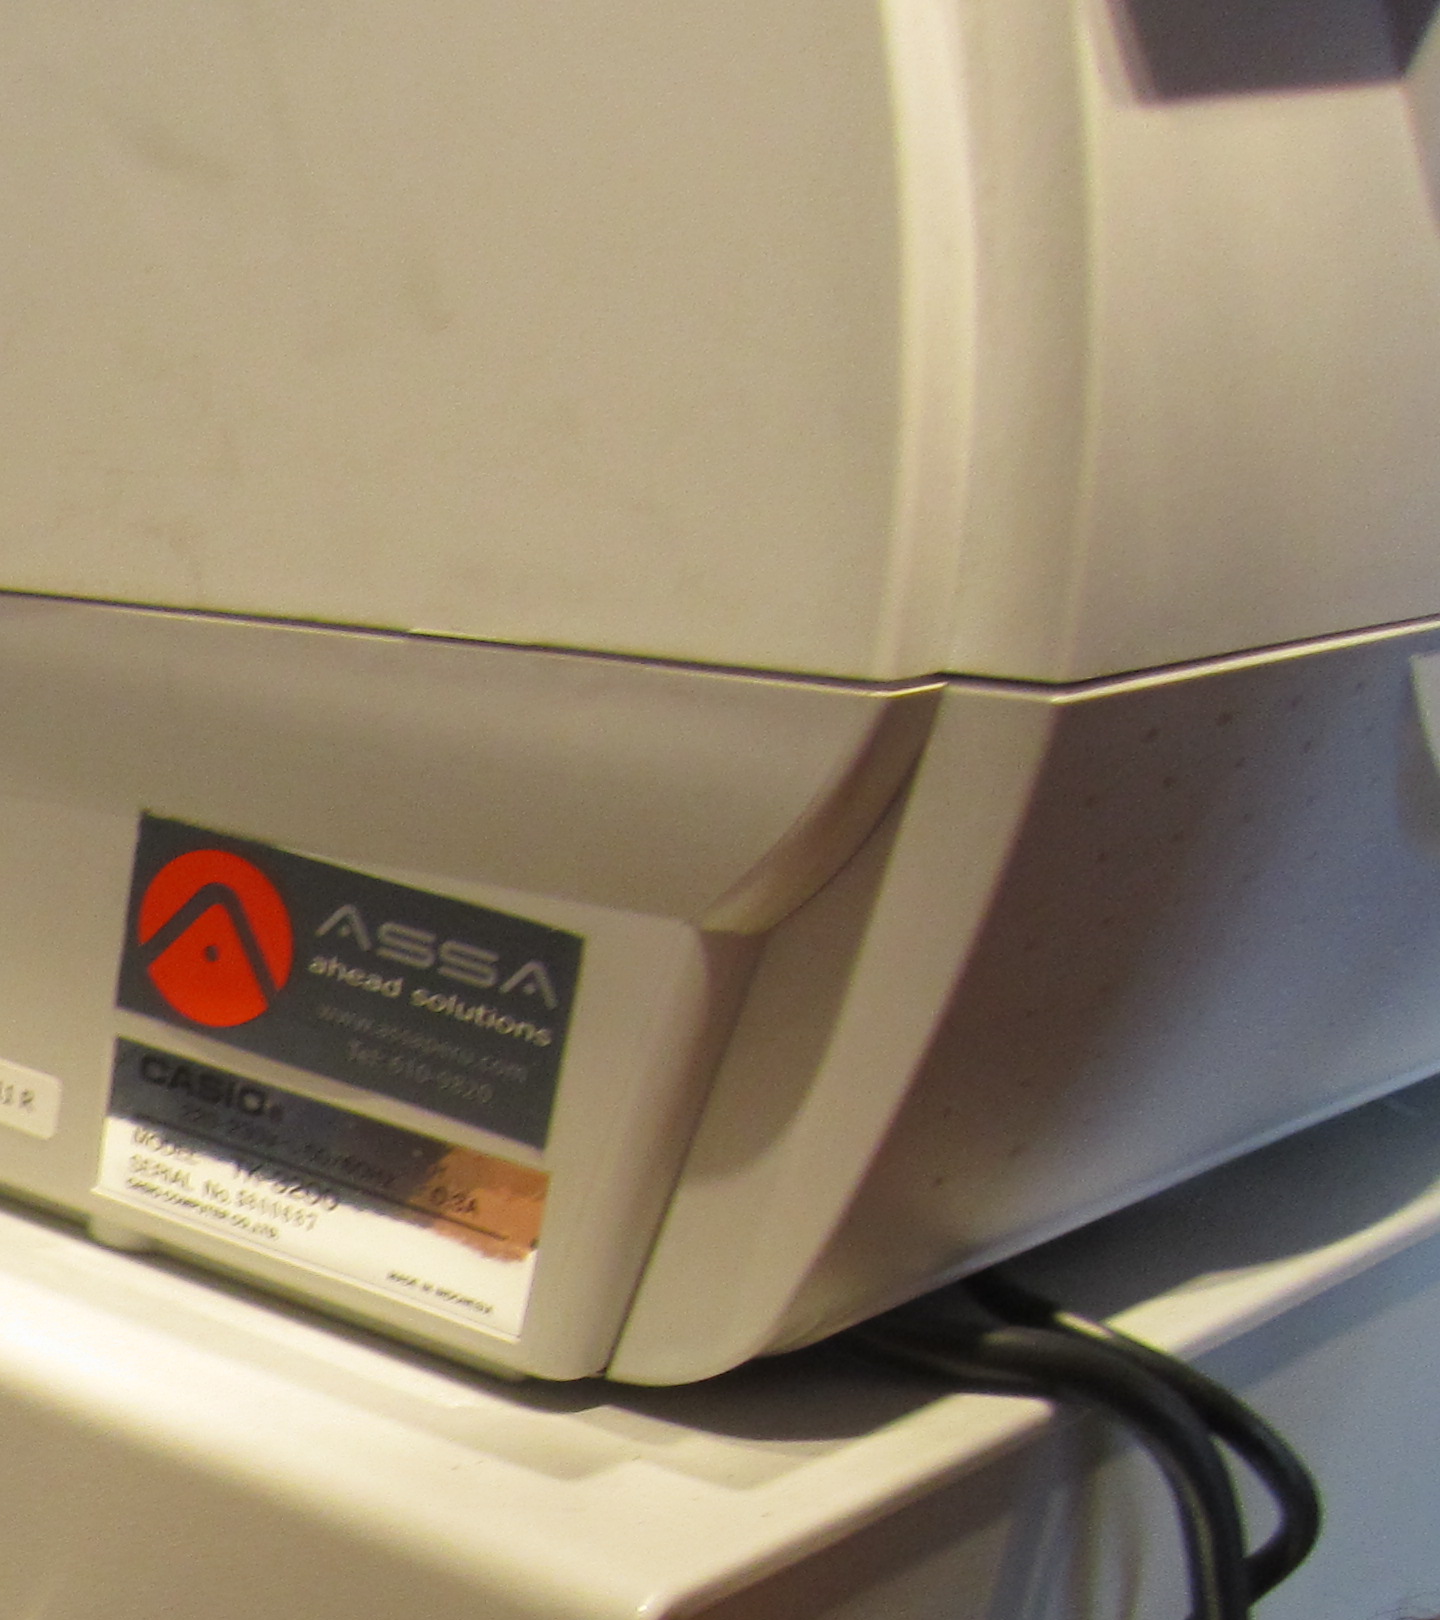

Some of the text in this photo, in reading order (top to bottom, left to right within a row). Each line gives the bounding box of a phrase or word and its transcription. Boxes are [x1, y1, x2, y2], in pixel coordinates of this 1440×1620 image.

[309, 955, 551, 1047] ahead solutions
[319, 904, 557, 1008] ASSA
[140, 1055, 267, 1112] CASIO
